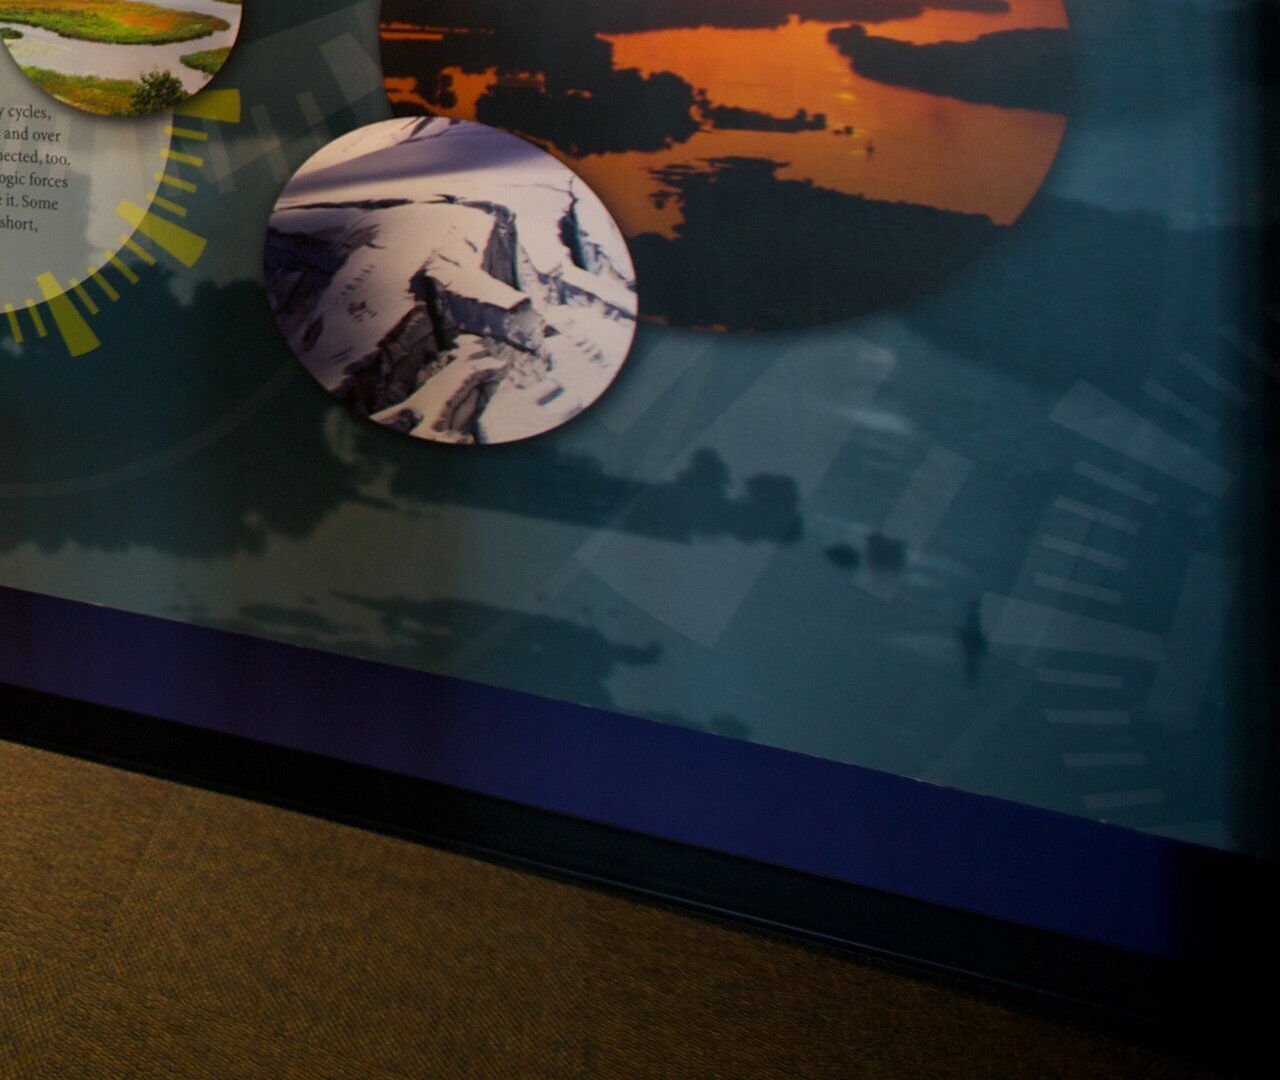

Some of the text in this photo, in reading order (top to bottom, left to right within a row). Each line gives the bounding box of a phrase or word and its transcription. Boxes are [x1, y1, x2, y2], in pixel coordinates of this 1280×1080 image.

[8, 104, 51, 121] cycles,
[4, 127, 28, 140] and
[33, 132, 61, 142] over
[46, 153, 71, 166] too.
[29, 172, 68, 188] forces
[6, 193, 19, 207] it.
[22, 194, 59, 210] Some
[0, 215, 38, 233] short,
